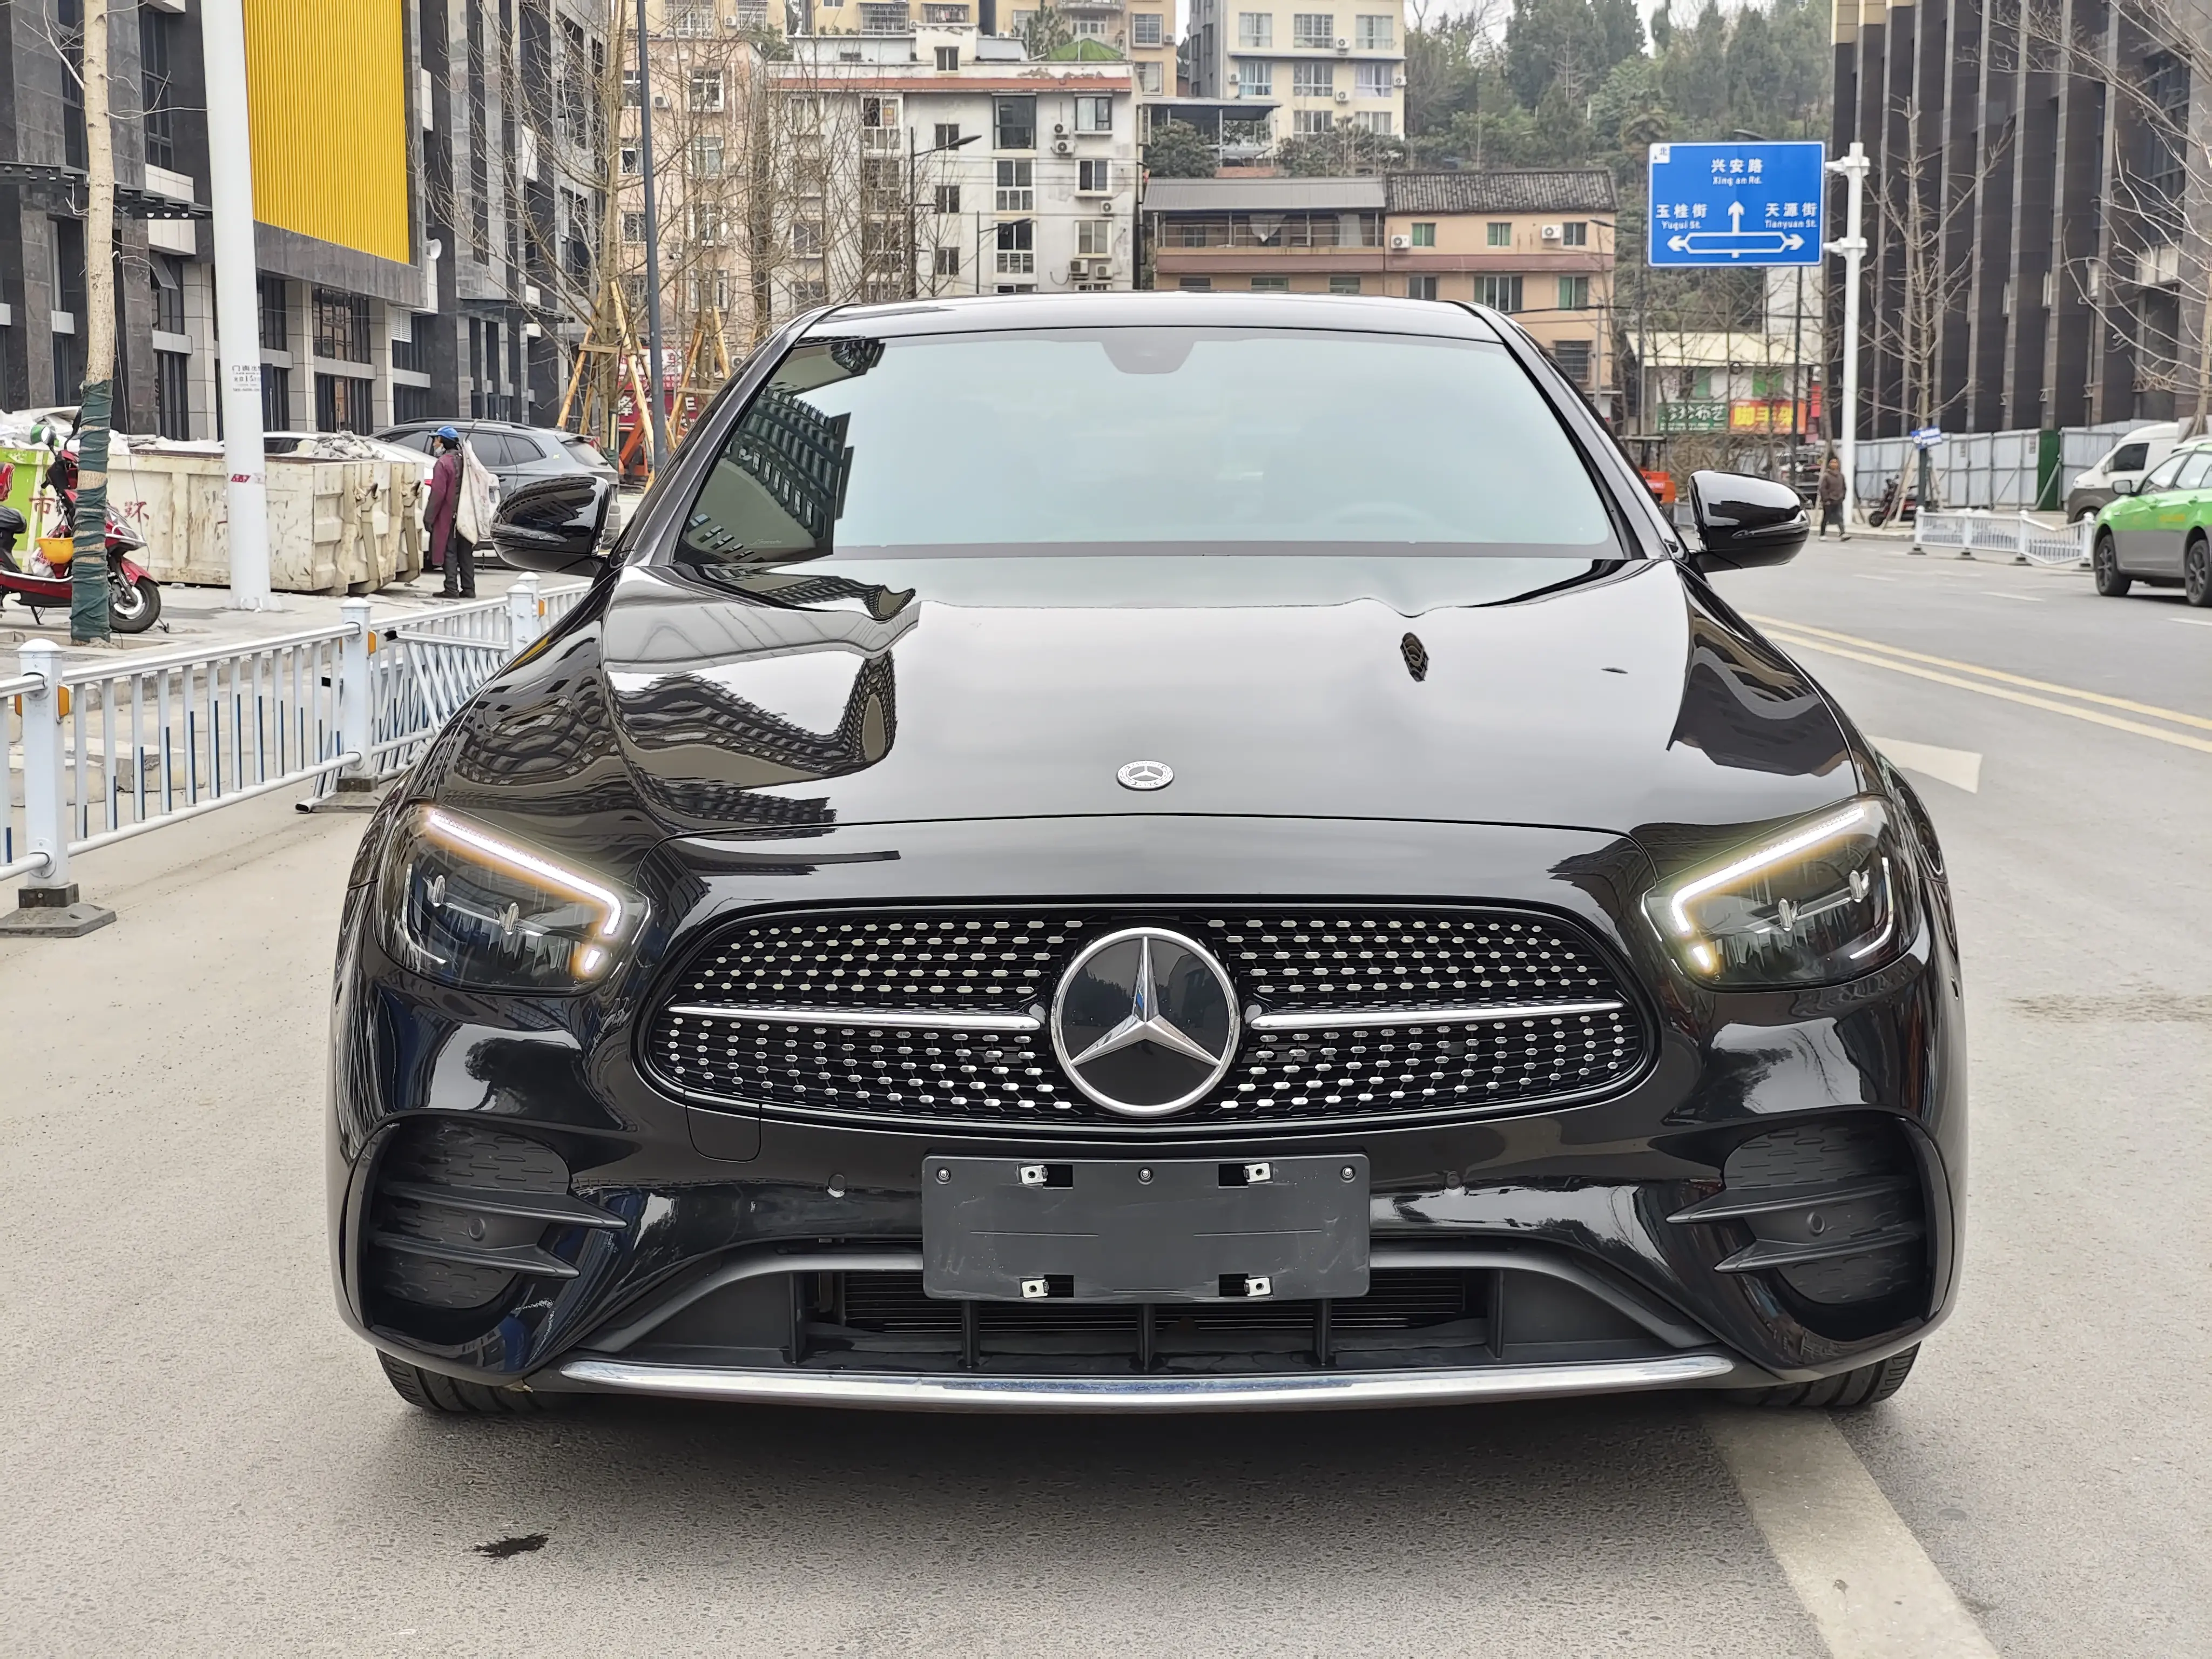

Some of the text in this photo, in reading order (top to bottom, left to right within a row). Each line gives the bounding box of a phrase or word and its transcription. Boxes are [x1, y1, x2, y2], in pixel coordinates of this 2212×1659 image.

[1659, 146, 1668, 156] 北
[1711, 158, 1763, 173] 兴安路
[1712, 176, 1733, 187] Xing
[1748, 176, 1762, 184] Rd.
[1655, 203, 1708, 219] 玉桂街
[1765, 202, 1817, 218] 天源街
[1689, 220, 1702, 229] St.
[1764, 219, 1817, 230] Tianyuan St.
